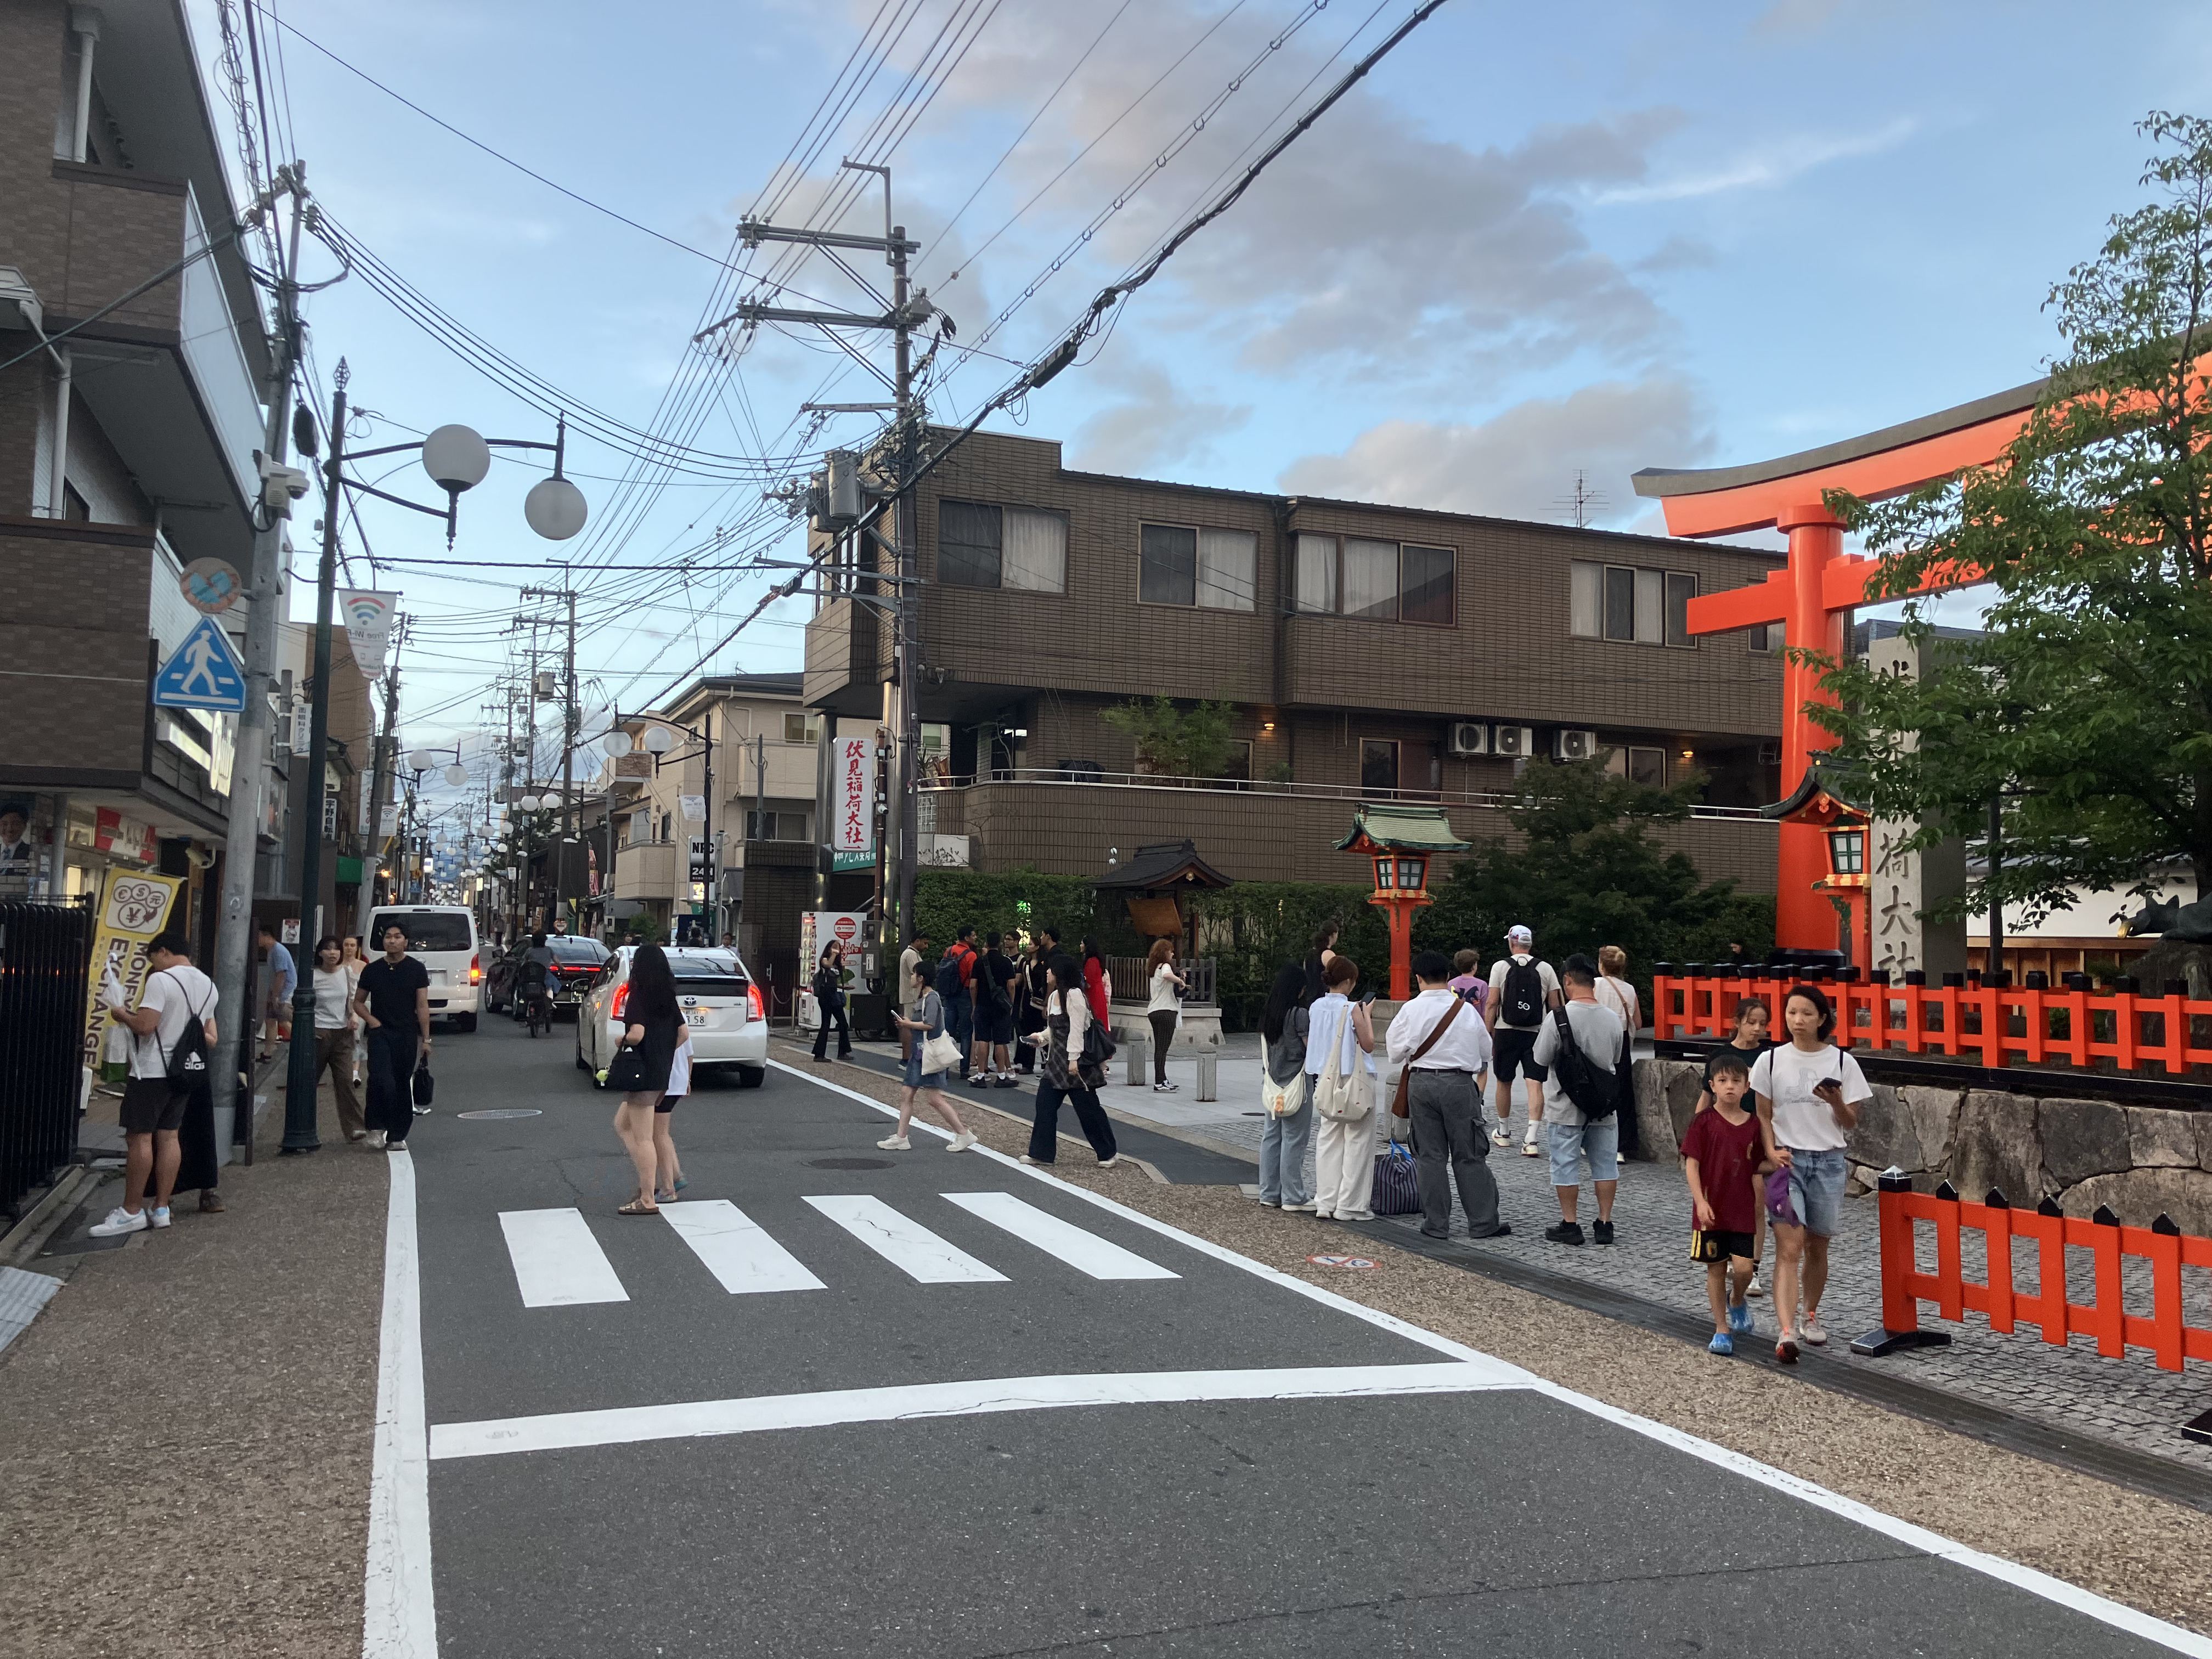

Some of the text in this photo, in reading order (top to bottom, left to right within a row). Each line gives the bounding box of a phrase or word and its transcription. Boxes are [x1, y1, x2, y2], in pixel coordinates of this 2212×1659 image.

[845, 740, 866, 844] 伏見稲荷大社
[1517, 1001, 1531, 1011] 50
[694, 1015, 704, 1024] 58
